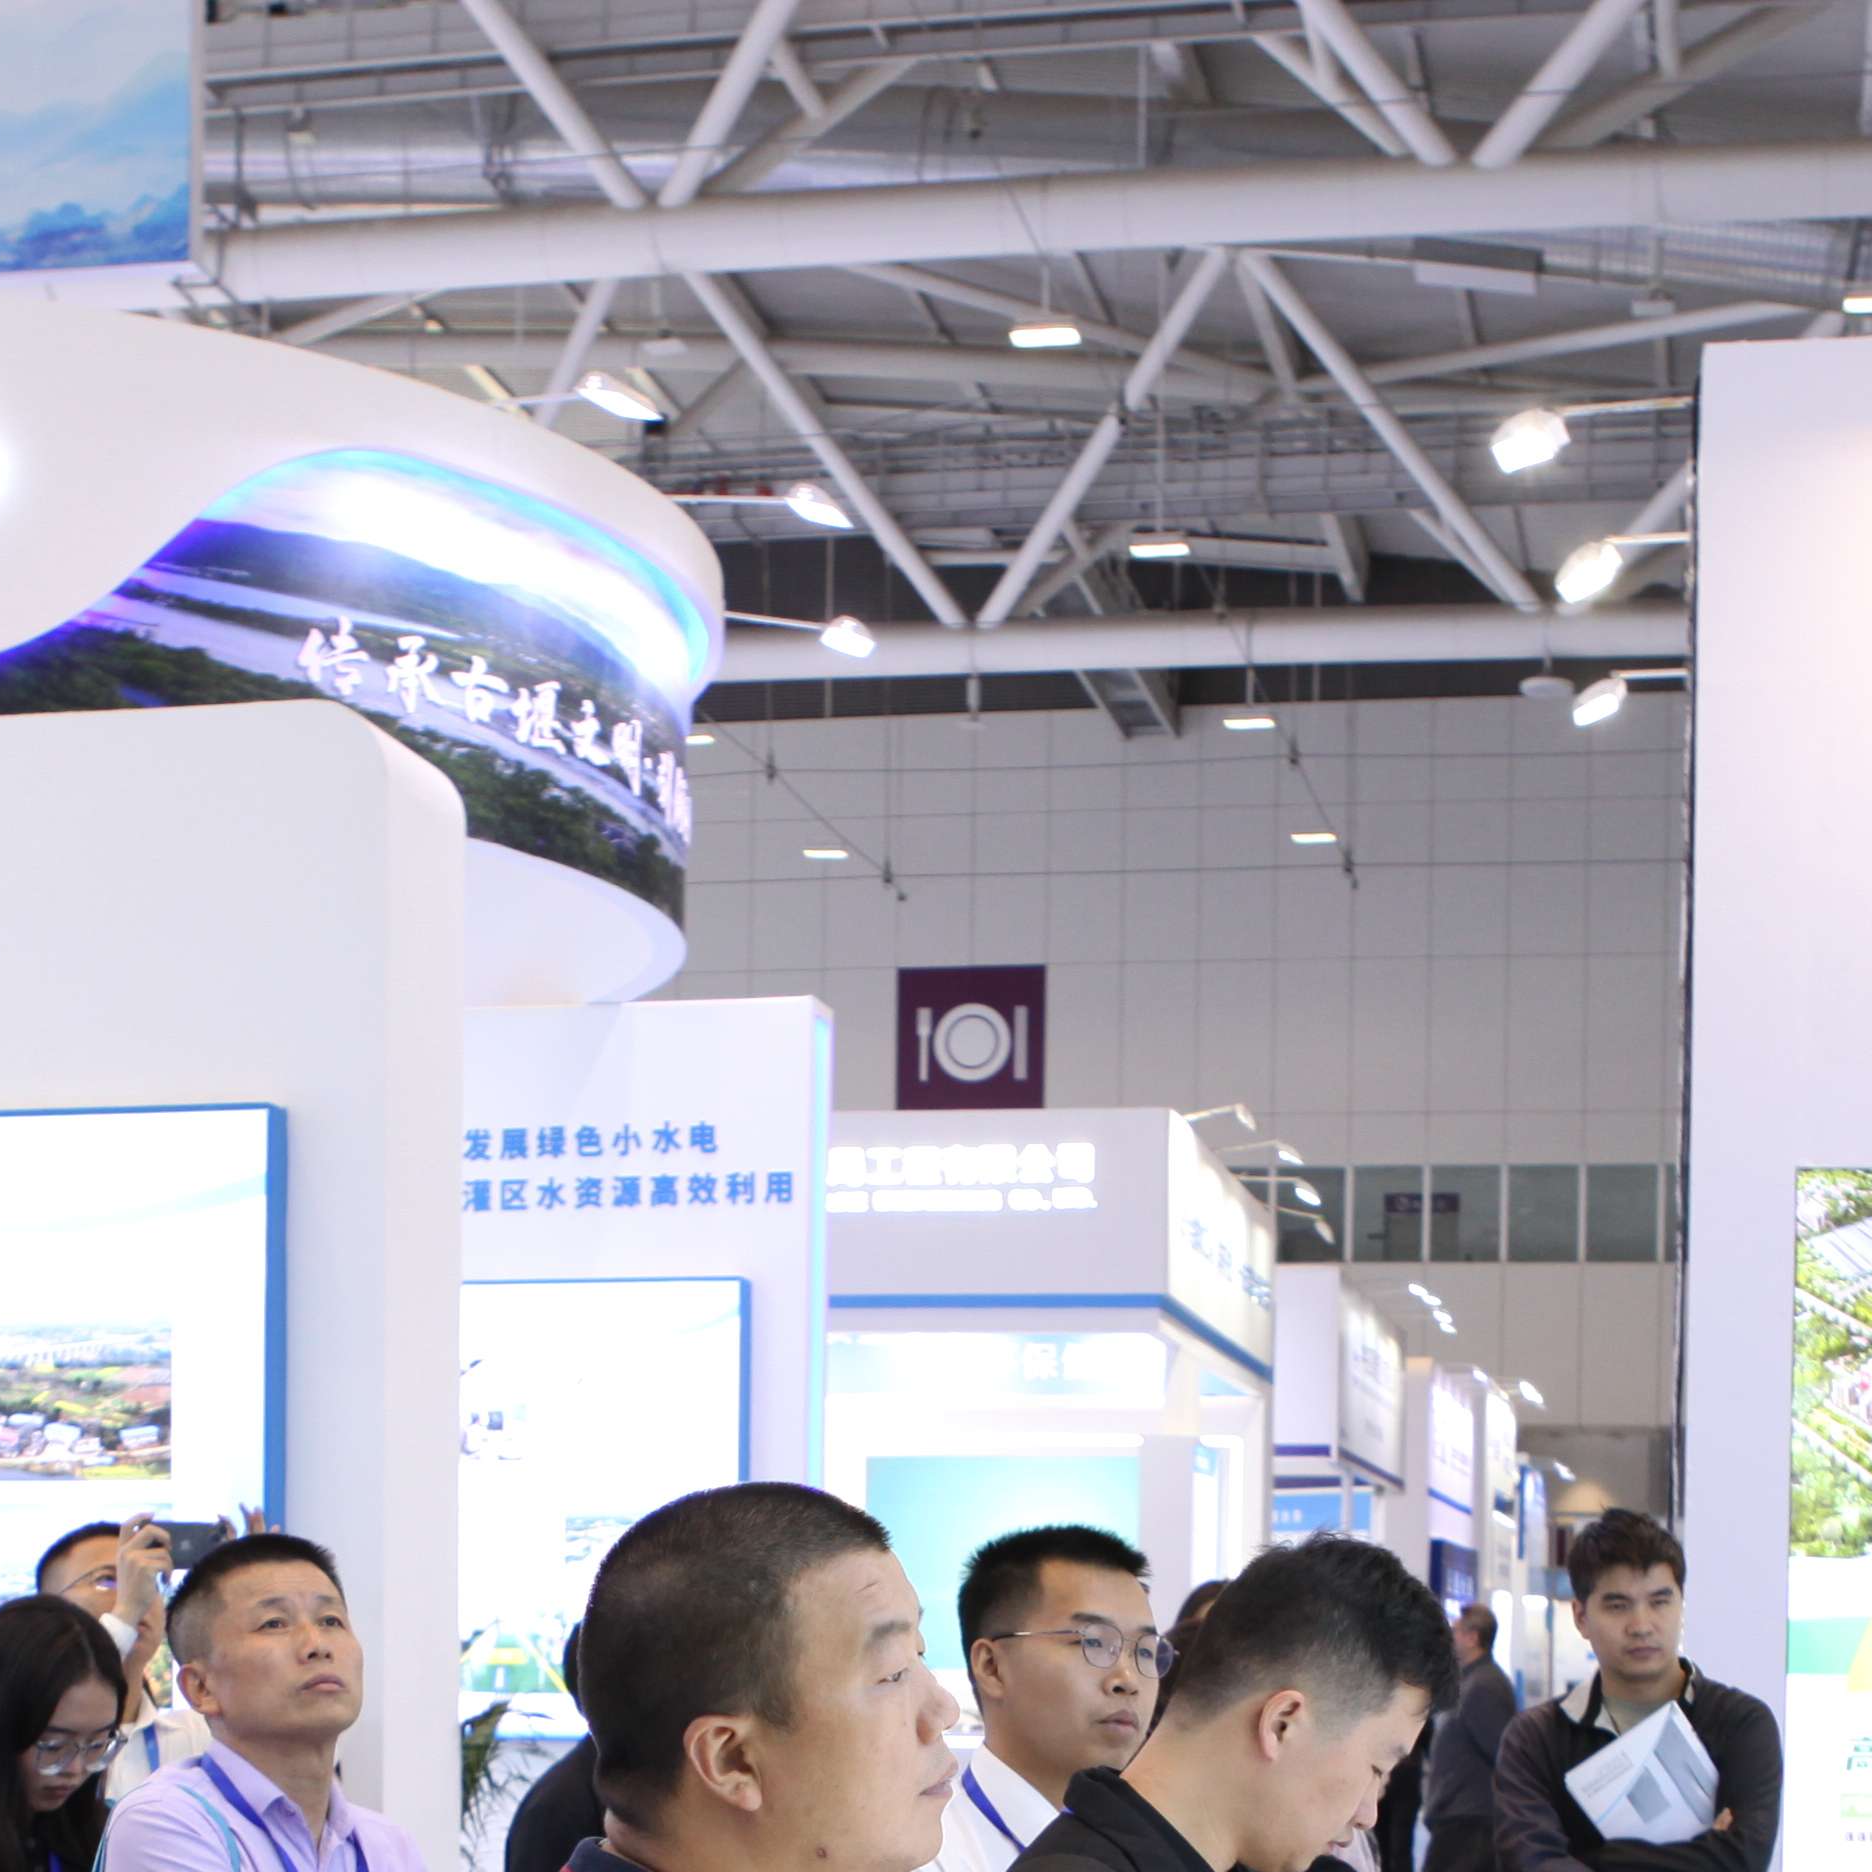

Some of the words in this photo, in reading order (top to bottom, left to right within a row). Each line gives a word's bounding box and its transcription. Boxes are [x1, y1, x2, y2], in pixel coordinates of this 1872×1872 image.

[462, 1120, 720, 1163] 发展绿色小水电
[462, 1170, 795, 1213] 灌区水资源高效利用
